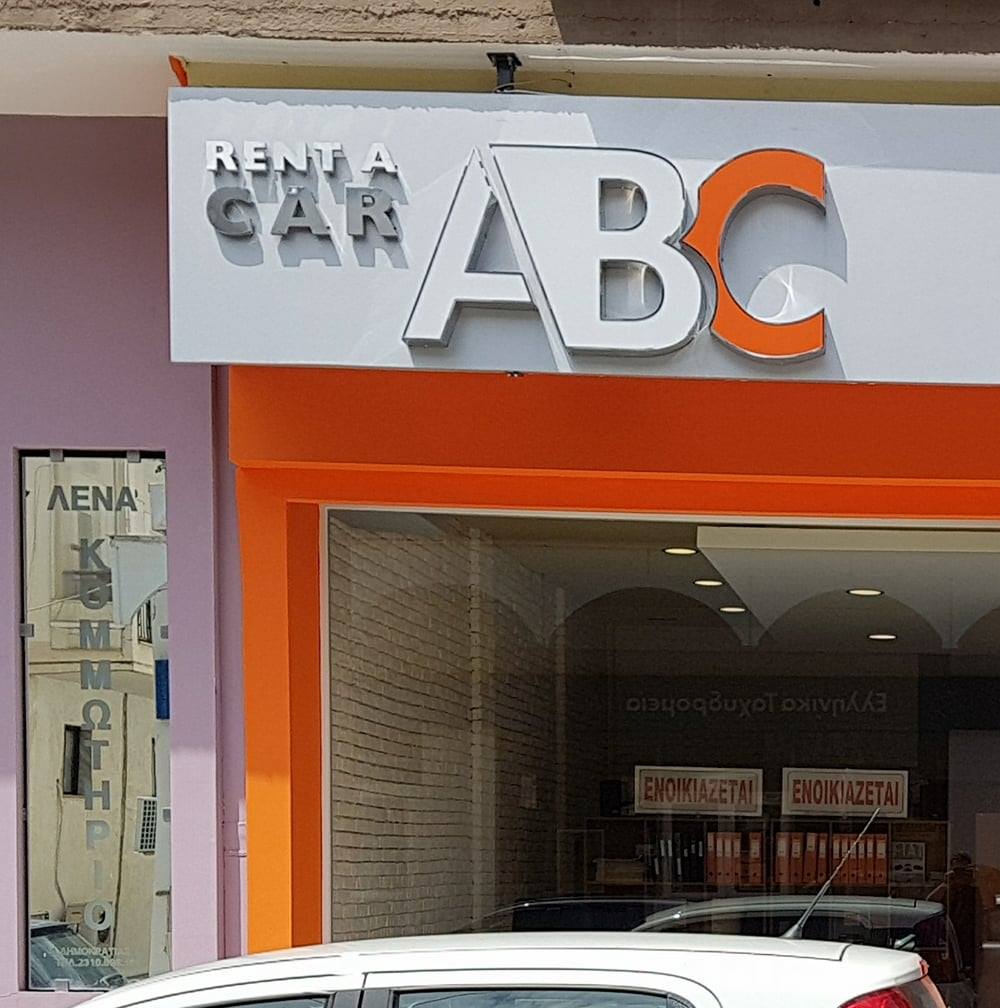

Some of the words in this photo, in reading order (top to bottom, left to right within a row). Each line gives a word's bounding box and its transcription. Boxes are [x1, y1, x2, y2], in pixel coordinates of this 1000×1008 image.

[205, 140, 344, 173] RENT
[361, 141, 399, 174] A
[206, 185, 399, 238] CAR
[402, 143, 828, 362] ABC
[644, 776, 753, 805] ΕΝΟΙΚΙΑΖΕΤΑΙ
[792, 779, 899, 806] ΕΝΟΙΚΙΑΖΕΤΑΙ
